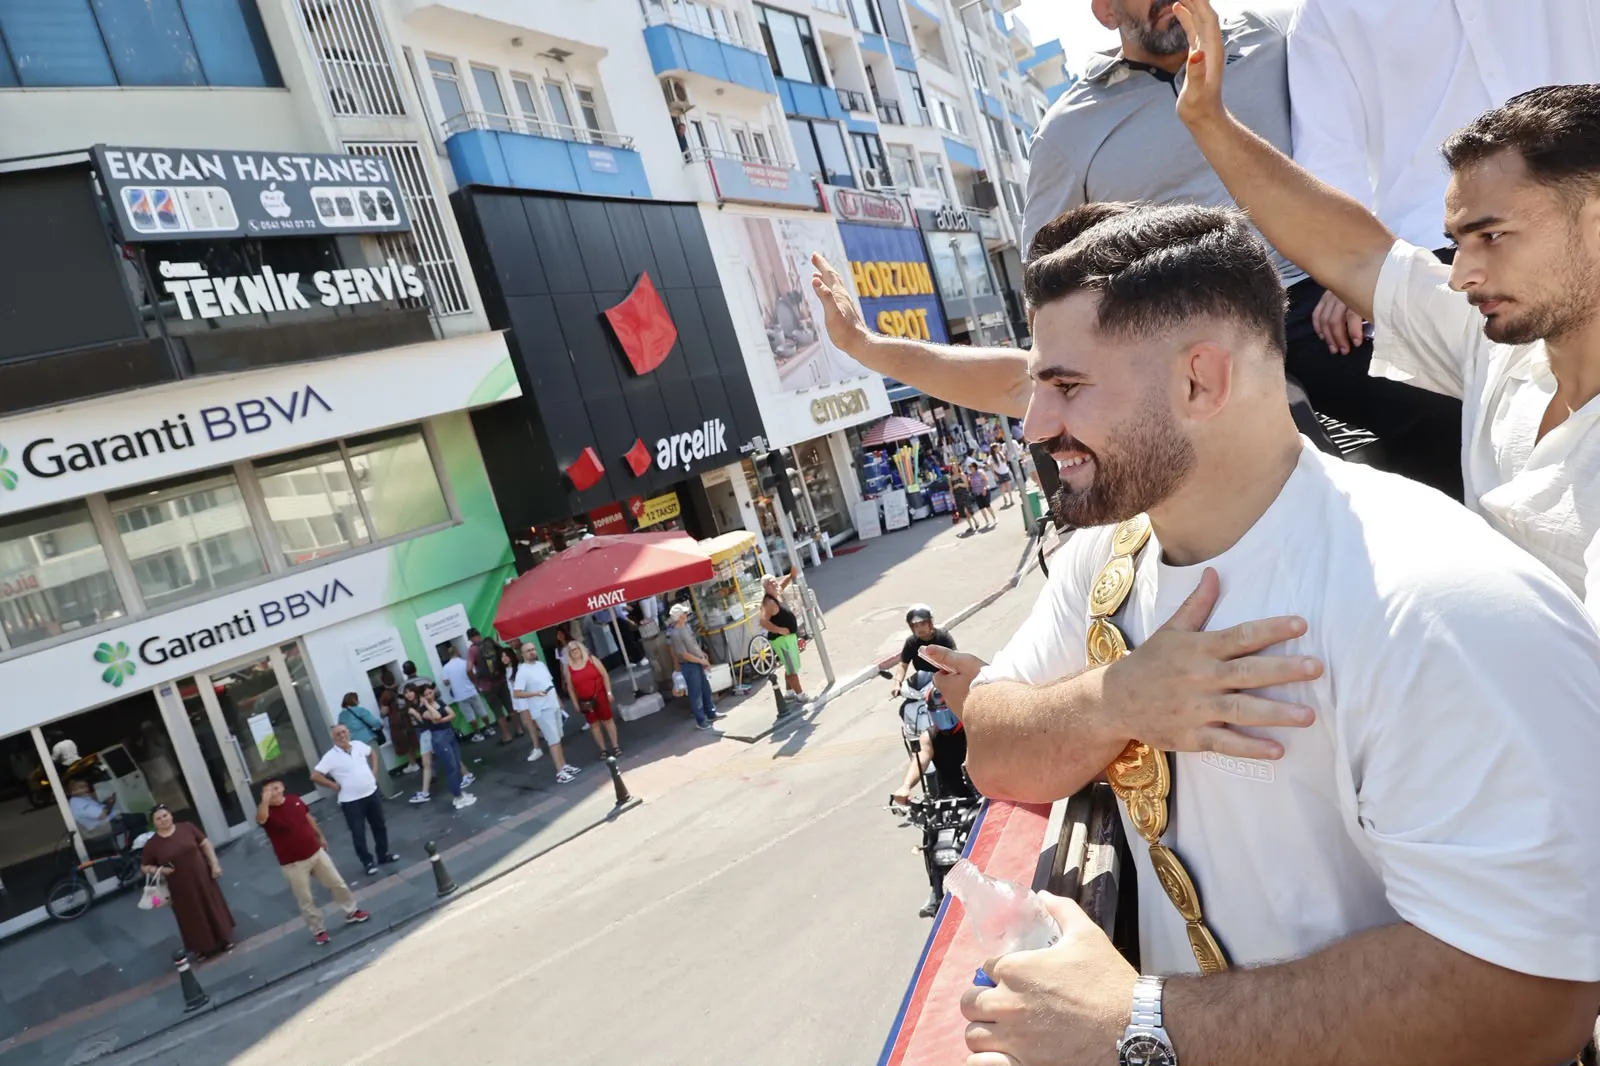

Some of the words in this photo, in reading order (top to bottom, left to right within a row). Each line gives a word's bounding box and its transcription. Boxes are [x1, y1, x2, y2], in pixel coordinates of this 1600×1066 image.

[104, 151, 226, 181] EKRAN
[232, 155, 391, 183] HASTANESİ
[159, 260, 208, 278] ÖL
[849, 260, 935, 299] HORZUM
[163, 264, 311, 320] TEKNİK
[312, 258, 425, 307] SERVİS
[876, 307, 931, 340] SPOT
[810, 386, 870, 424] emsan
[22, 412, 195, 478] Garanti
[200, 384, 333, 442] BBVA
[656, 418, 728, 472] arçelik
[646, 512, 656, 522] 12
[587, 588, 626, 610] HAYAT
[139, 609, 256, 666] Garanti
[259, 579, 354, 627] BBVA
